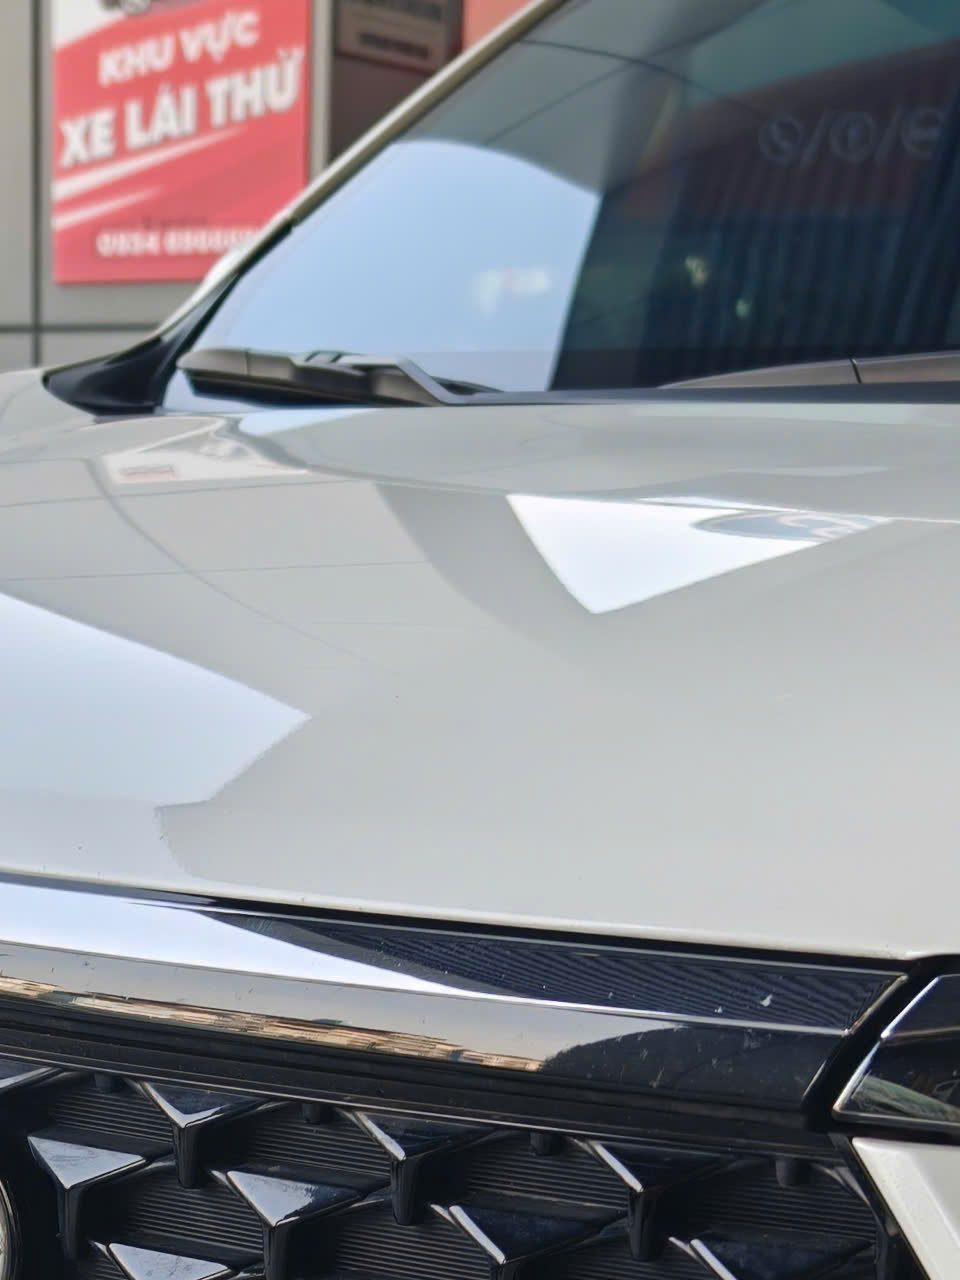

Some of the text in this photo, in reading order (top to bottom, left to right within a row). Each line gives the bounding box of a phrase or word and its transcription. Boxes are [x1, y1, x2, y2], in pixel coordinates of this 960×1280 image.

[98, 9, 260, 88] KHU VỰC
[59, 44, 306, 168] XE LÁI THỬ
